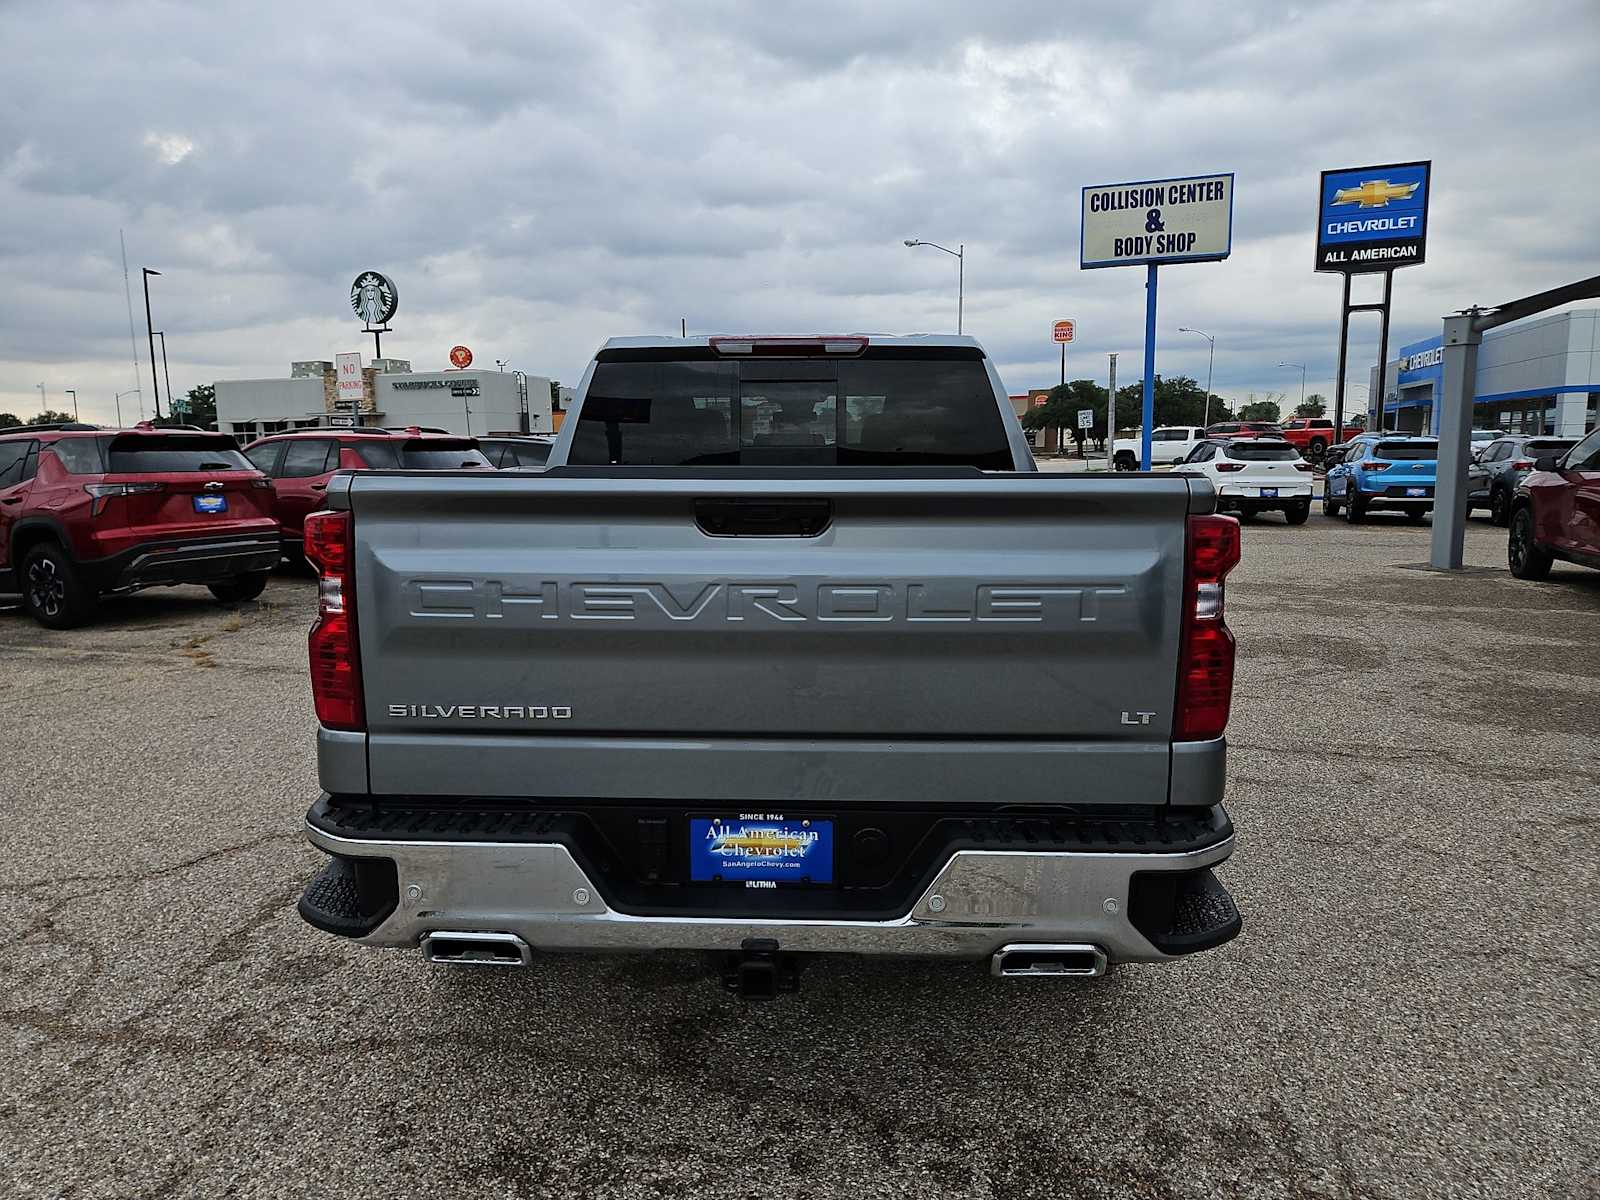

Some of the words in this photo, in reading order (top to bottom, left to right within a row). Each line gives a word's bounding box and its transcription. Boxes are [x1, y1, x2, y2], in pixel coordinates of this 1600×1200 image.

[1091, 187, 1165, 212] COLLISION
[1168, 181, 1224, 205] CENTER
[1145, 208, 1165, 233] &
[1327, 216, 1417, 235] CHEVROLET
[1114, 236, 1153, 257] BODY
[1156, 232, 1196, 253] SHOP
[1324, 249, 1347, 263] ALL
[1350, 245, 1417, 261] AMERICAN
[1409, 346, 1445, 370] CHEVROLET
[343, 363, 355, 375] NO
[338, 379, 363, 390] PARKING
[408, 579, 1128, 623] CHEVROLET
[387, 704, 574, 720] SILVERADO
[1120, 711, 1156, 726] LT
[739, 813, 764, 821] SINCE
[705, 826, 730, 841] All
[737, 826, 819, 841] American
[721, 843, 806, 858] Chevrolet
[722, 860, 801, 868] SanAngeloChevy.com
[752, 880, 777, 889] LITHIA
